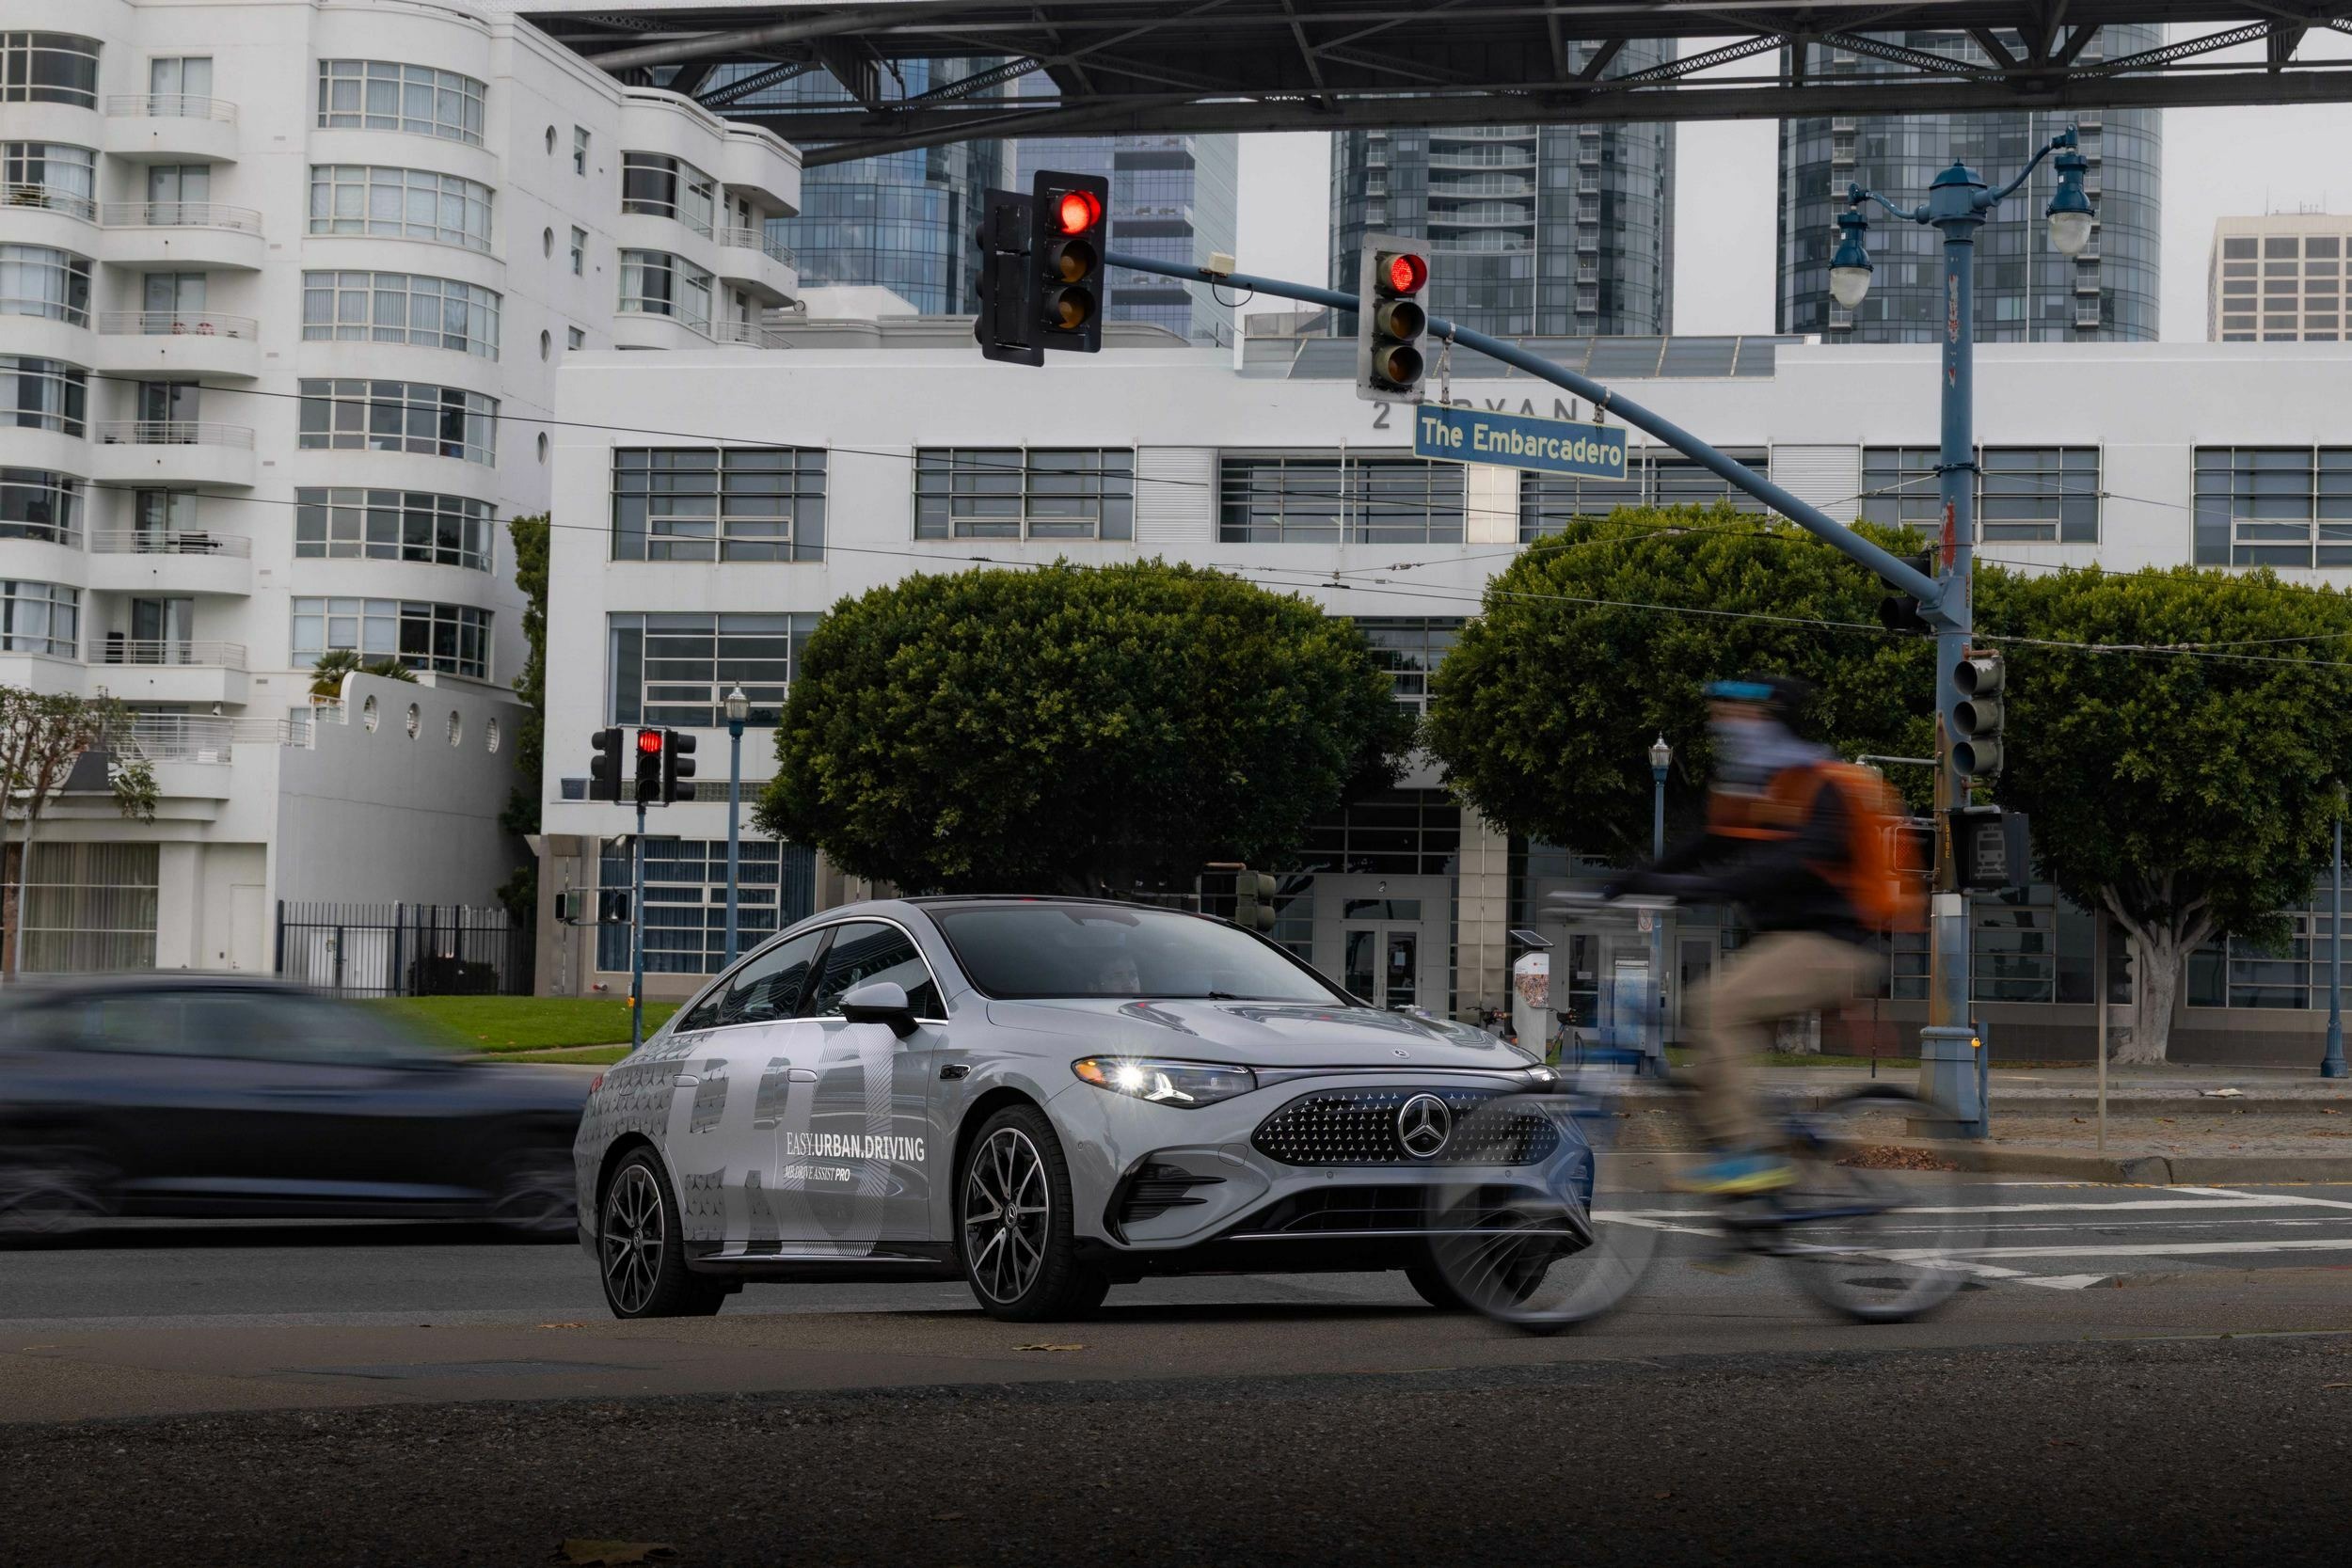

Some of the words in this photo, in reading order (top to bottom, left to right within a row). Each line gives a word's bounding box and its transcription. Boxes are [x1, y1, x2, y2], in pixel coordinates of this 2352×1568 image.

[1373, 401, 1390, 429] 2
[1422, 417, 1464, 448] The
[1473, 423, 1622, 467] Embarcadero
[787, 1132, 925, 1162] EASY.URBAN.DRIVING
[813, 1167, 834, 1181] ASSIST
[834, 1168, 850, 1181] PRO
